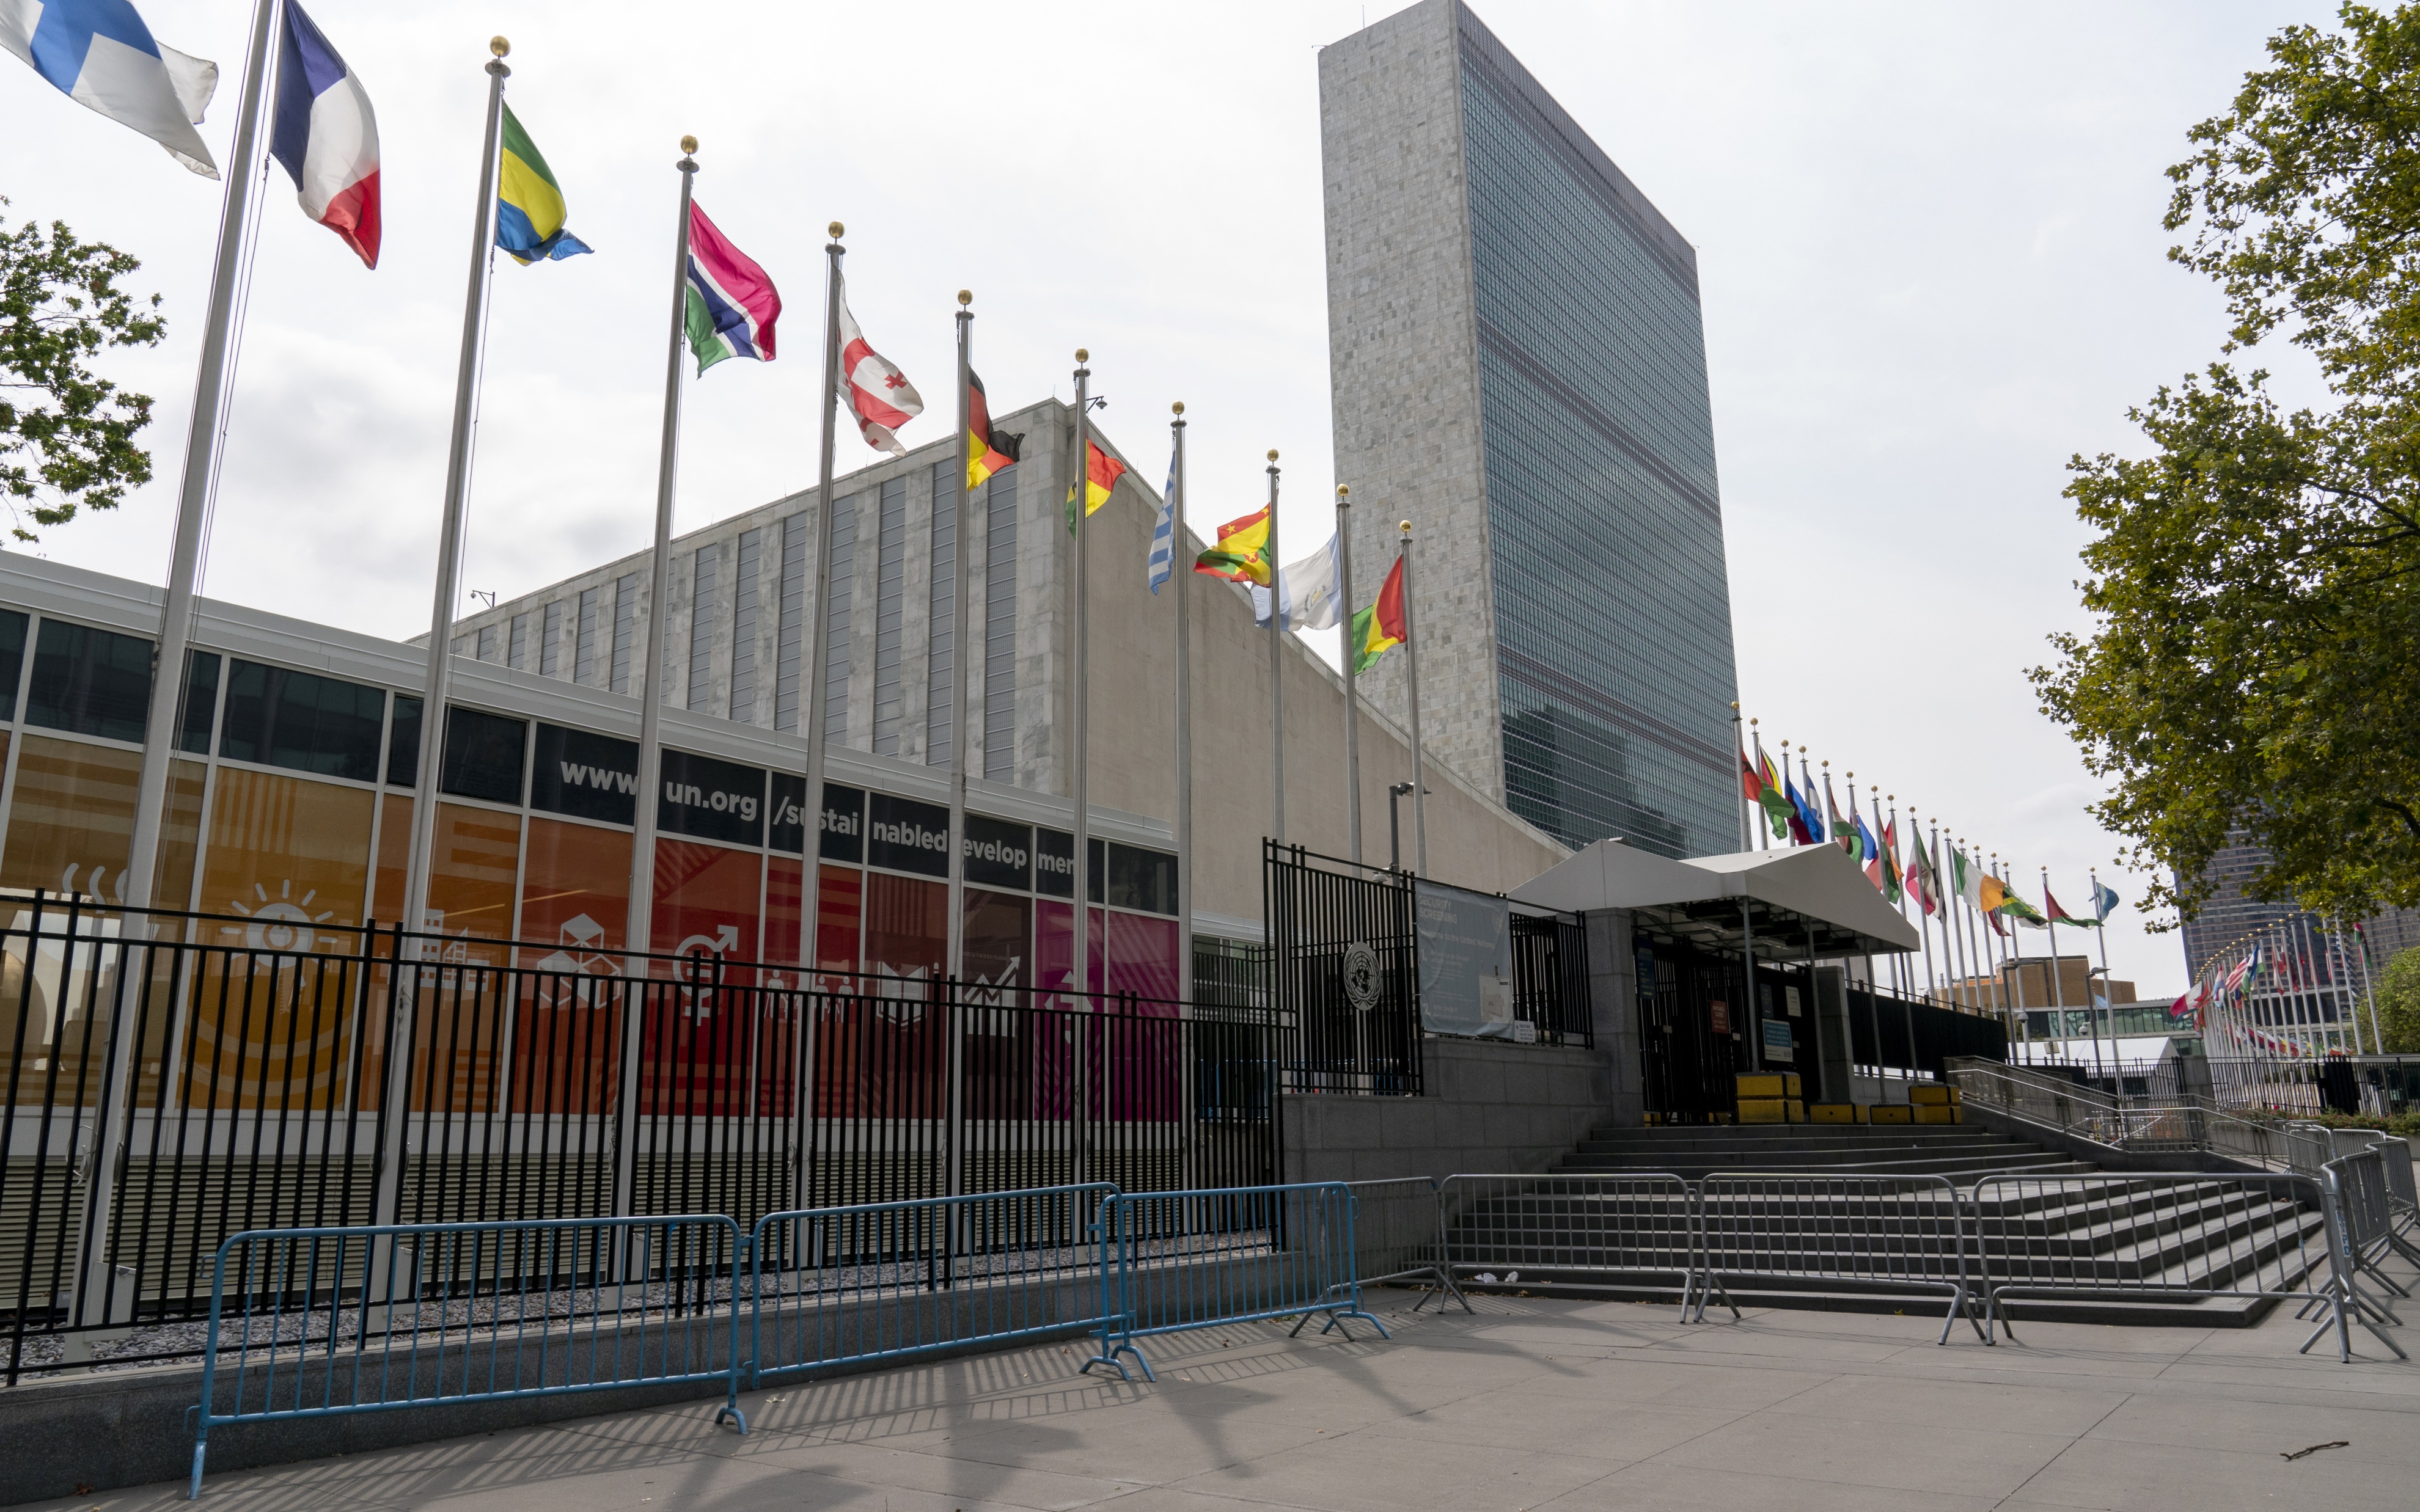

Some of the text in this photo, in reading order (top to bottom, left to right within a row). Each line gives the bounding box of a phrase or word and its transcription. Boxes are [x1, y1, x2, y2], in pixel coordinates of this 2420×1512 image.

[1038, 853, 1074, 875] men
[1418, 894, 1451, 910] SECURITY
[1418, 907, 1458, 924] SCREENING
[1451, 933, 1459, 942] the
[1460, 935, 1476, 945] United
[1477, 939, 1495, 949] Nations
